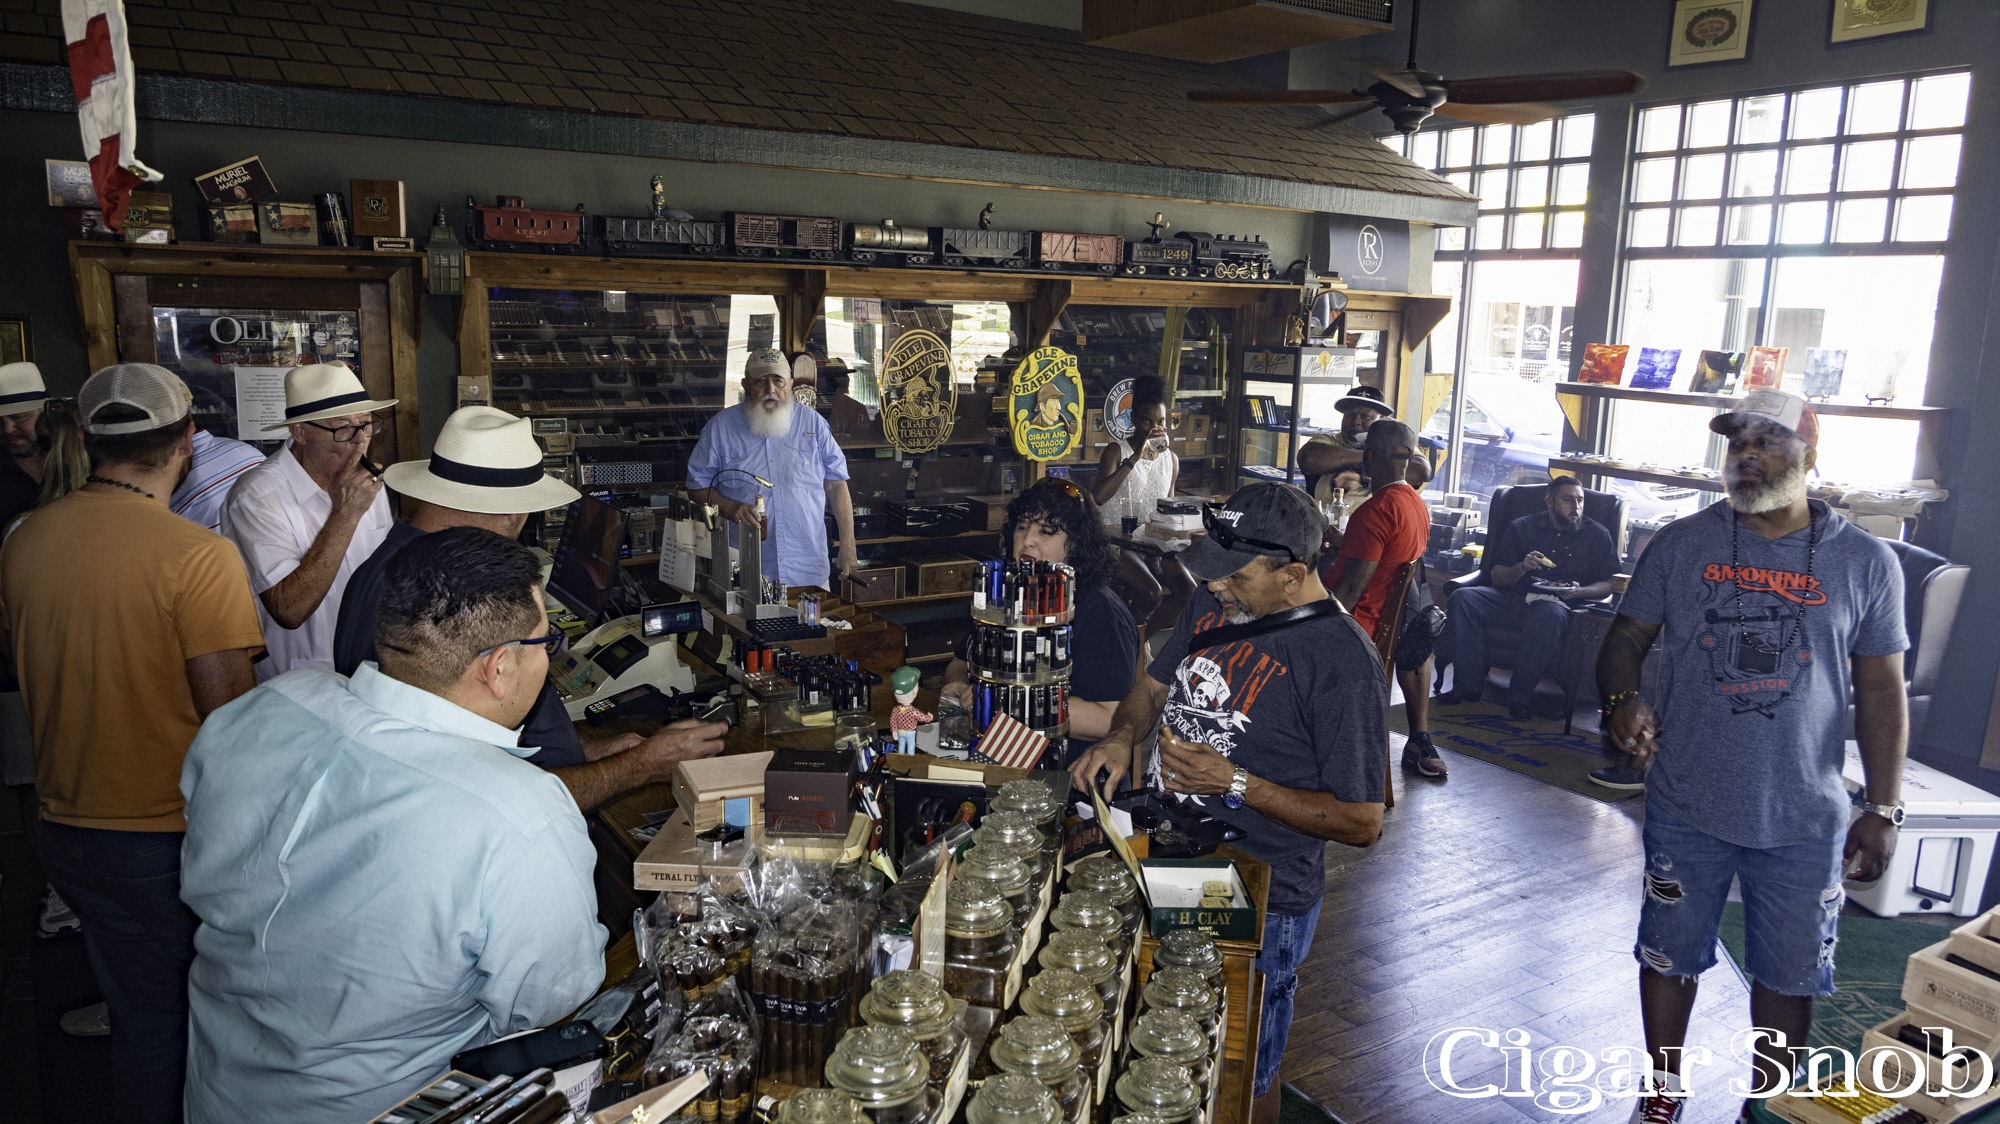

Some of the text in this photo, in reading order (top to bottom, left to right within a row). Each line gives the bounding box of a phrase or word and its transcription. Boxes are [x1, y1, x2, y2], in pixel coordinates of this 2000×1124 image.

[214, 166, 249, 185] MURIEL
[218, 174, 252, 191] MAGNUM
[1162, 249, 1188, 260] 1249
[1362, 259, 1378, 268] ROJAS
[209, 316, 293, 345] OLIV
[899, 342, 922, 362] OLE
[1034, 348, 1058, 360] OLE
[890, 351, 945, 382] GRAPEVINE
[1013, 357, 1077, 394] GRAPEVINE
[1109, 382, 1126, 401] DREW
[901, 420, 937, 429] CIGAR &
[900, 428, 938, 438] TOBACCO
[1028, 433, 1051, 441] CIGAR
[908, 437, 930, 447] SHOP
[1030, 440, 1065, 449] TOBACCO
[1037, 447, 1058, 455] SHOP
[1702, 562, 1828, 606] SMOKING
[1722, 679, 1788, 694] PASSION
[1174, 716, 1191, 735] FOR
[1179, 911, 1233, 925] H. CLAY
